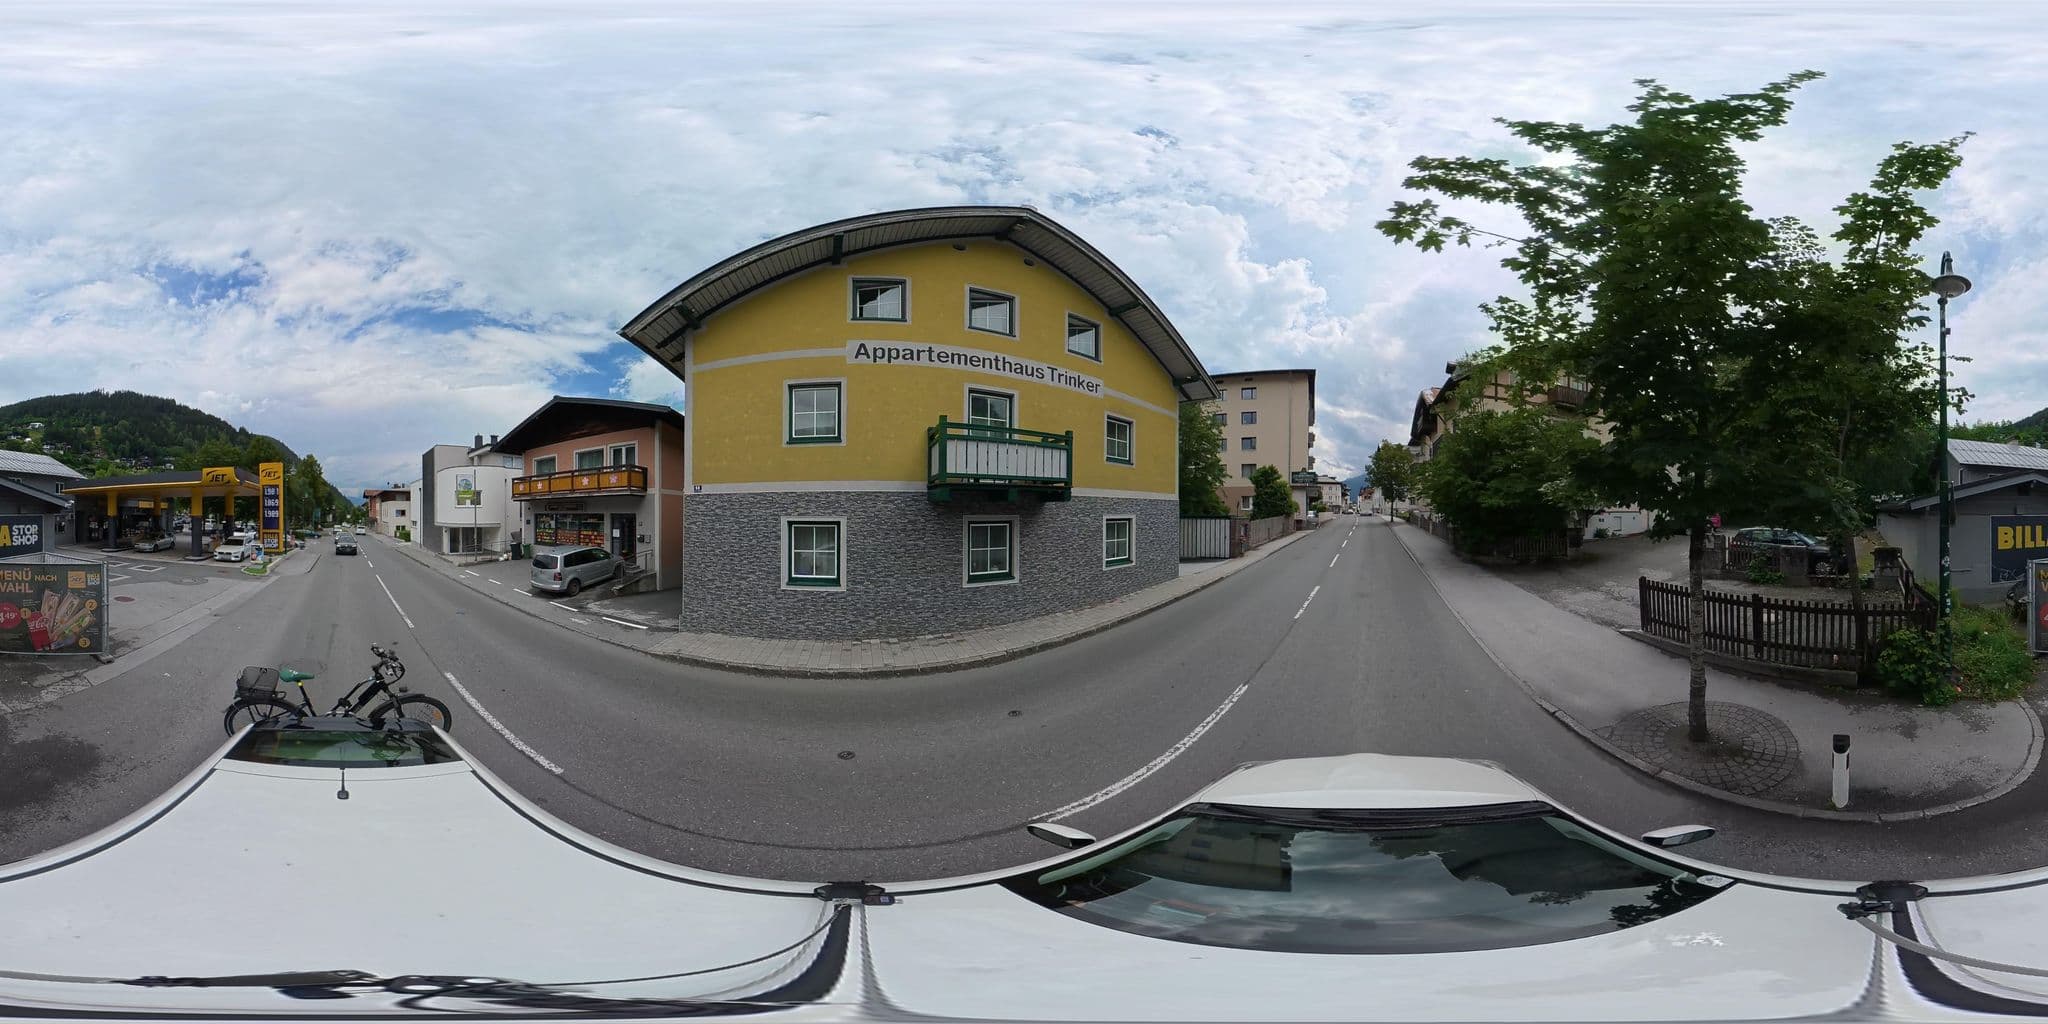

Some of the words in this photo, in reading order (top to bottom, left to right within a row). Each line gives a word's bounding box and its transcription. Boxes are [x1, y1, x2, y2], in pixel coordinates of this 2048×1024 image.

[854, 342, 1045, 380] Appartementhaus
[1047, 366, 1102, 394] Trinker
[209, 473, 227, 482] JET
[12, 524, 38, 535] STOP
[12, 535, 38, 546] SHOP
[1997, 525, 2048, 550] BILL
[34, 574, 57, 582] NACH
